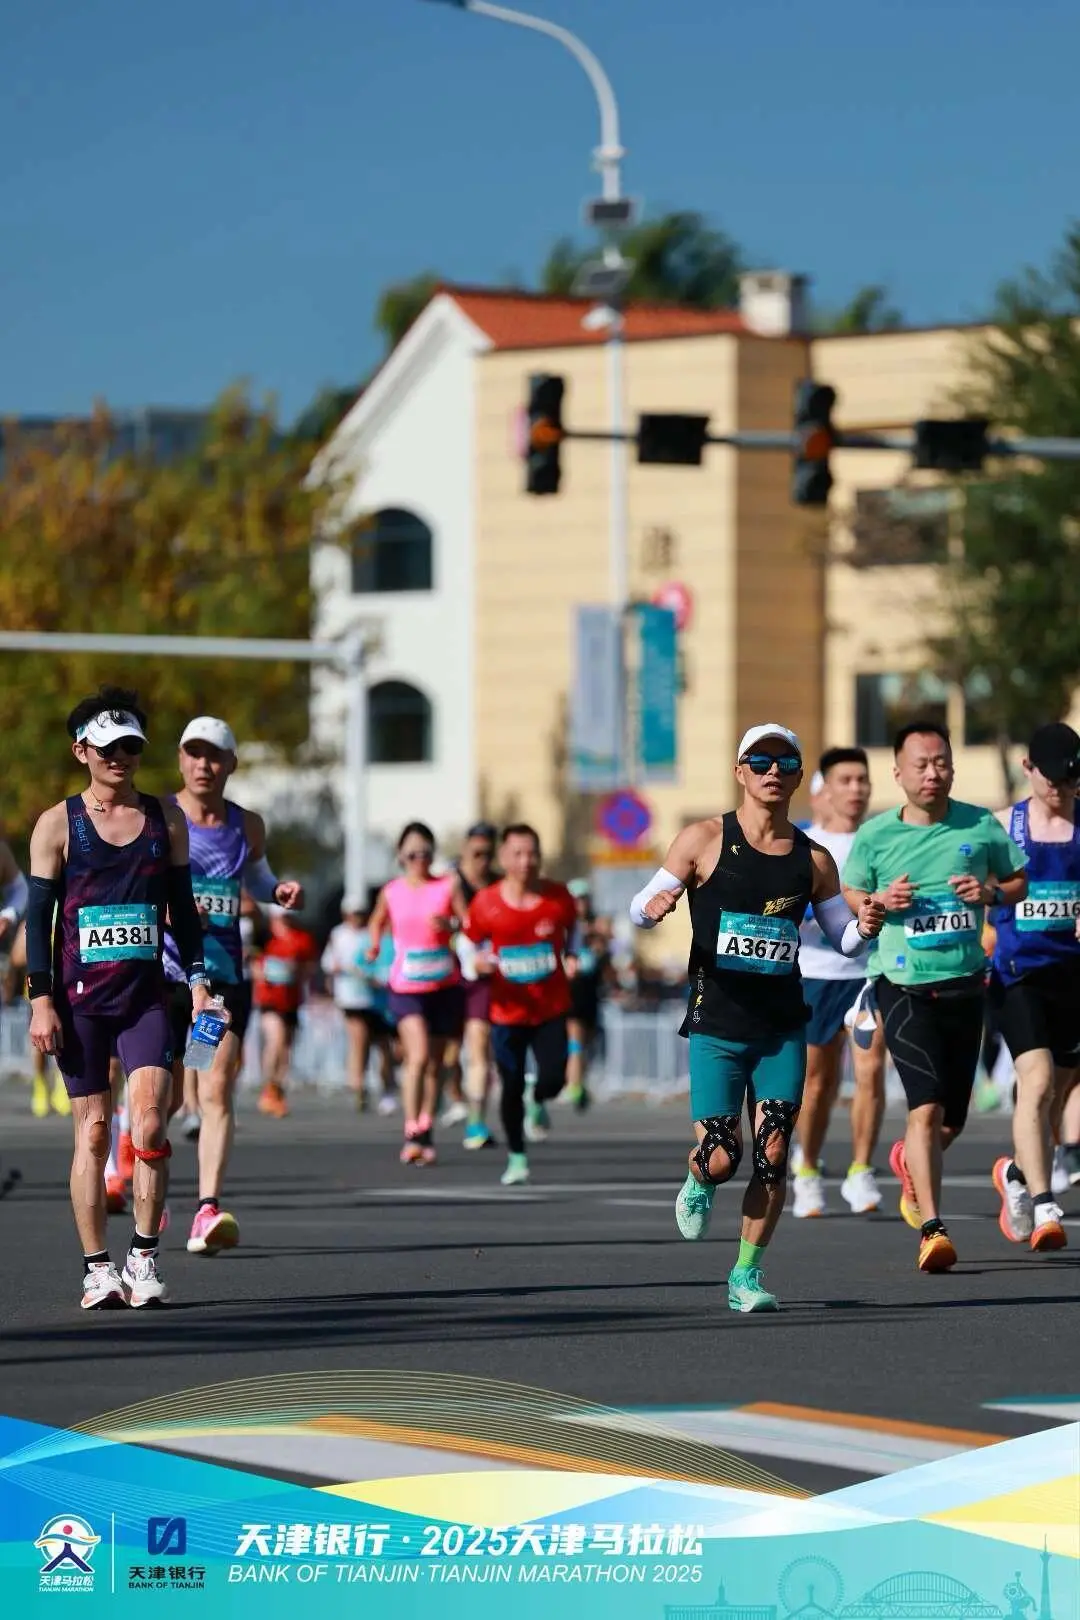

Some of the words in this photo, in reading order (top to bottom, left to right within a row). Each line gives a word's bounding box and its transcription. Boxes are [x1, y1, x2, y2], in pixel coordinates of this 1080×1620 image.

[1023, 901, 1080, 919] B4216
[912, 912, 971, 935] A4701
[88, 926, 153, 948] A4381
[725, 936, 792, 961] A3672
